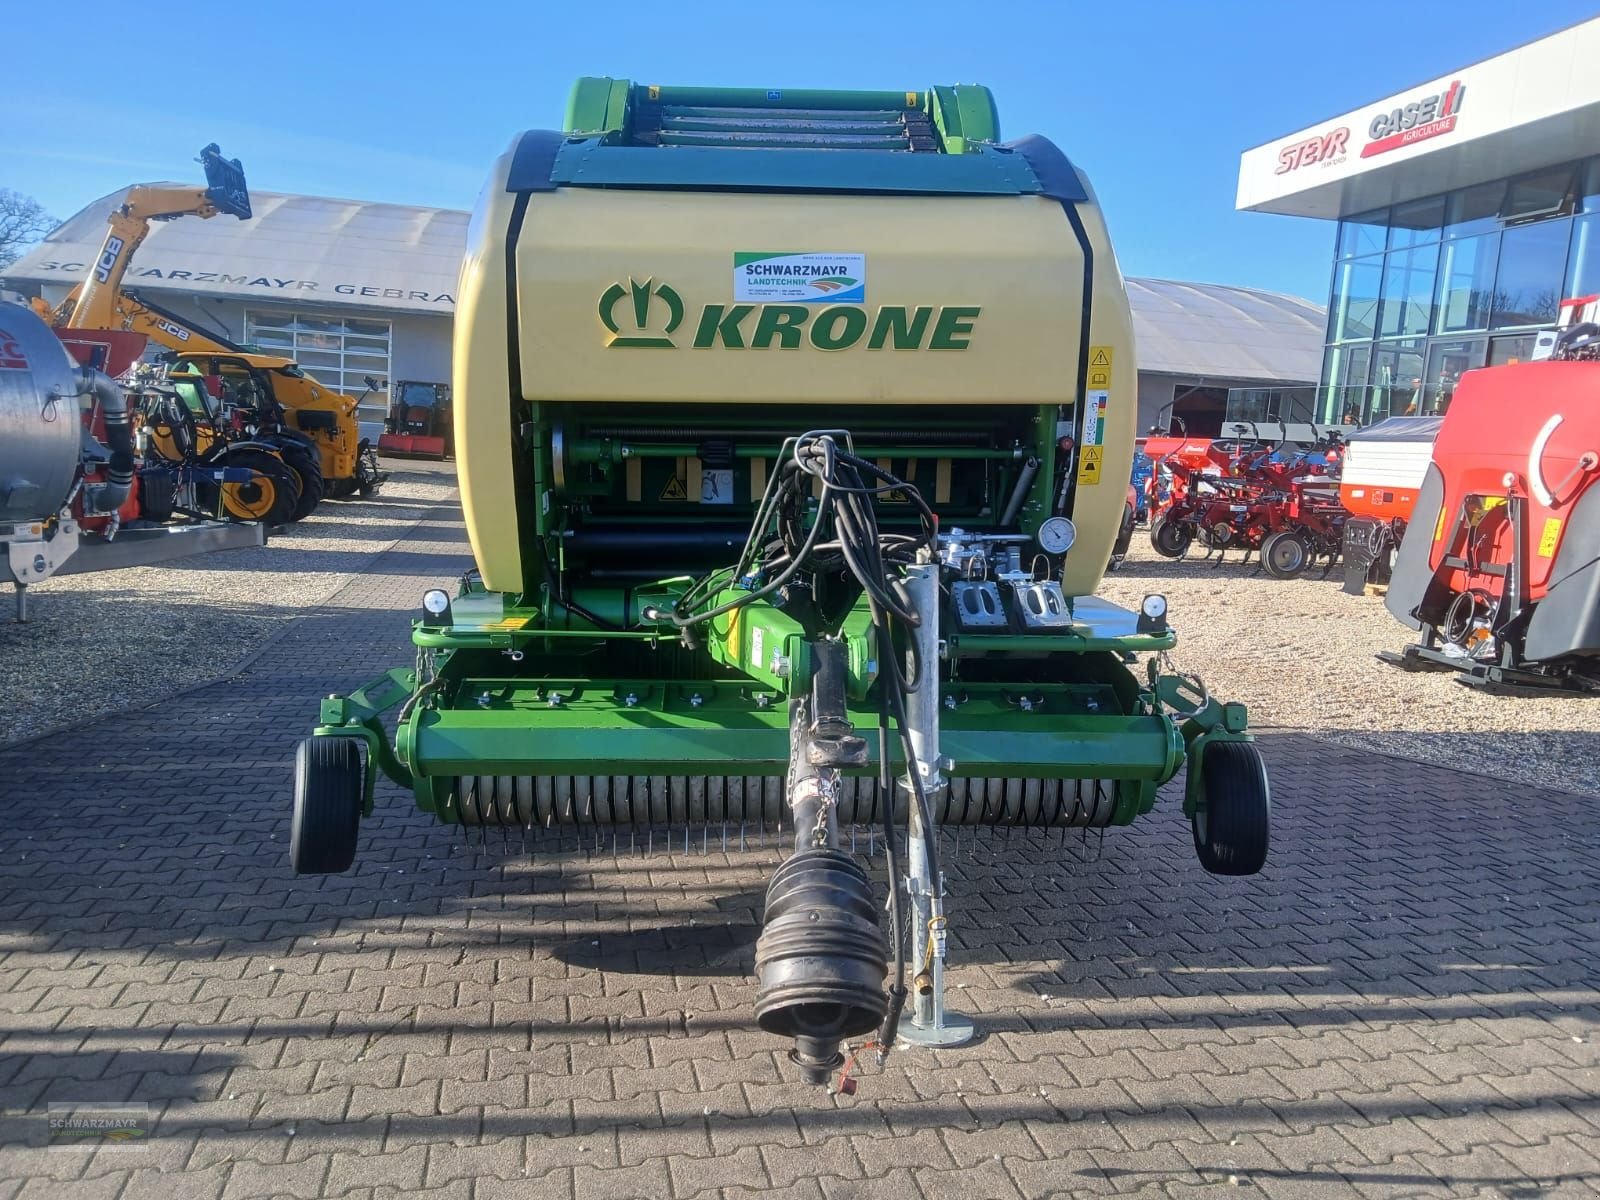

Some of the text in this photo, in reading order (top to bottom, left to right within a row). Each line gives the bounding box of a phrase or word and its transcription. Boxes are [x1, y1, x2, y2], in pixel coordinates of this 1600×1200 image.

[1402, 118, 1452, 143] AGRICULTURE
[1275, 127, 1350, 175] STEYR
[95, 236, 123, 284] JCB
[746, 264, 848, 276] SCHWARZMAYR
[748, 278, 807, 287] LANDTECHNIK
[158, 321, 190, 342] JCB
[691, 303, 982, 352] KRONE
